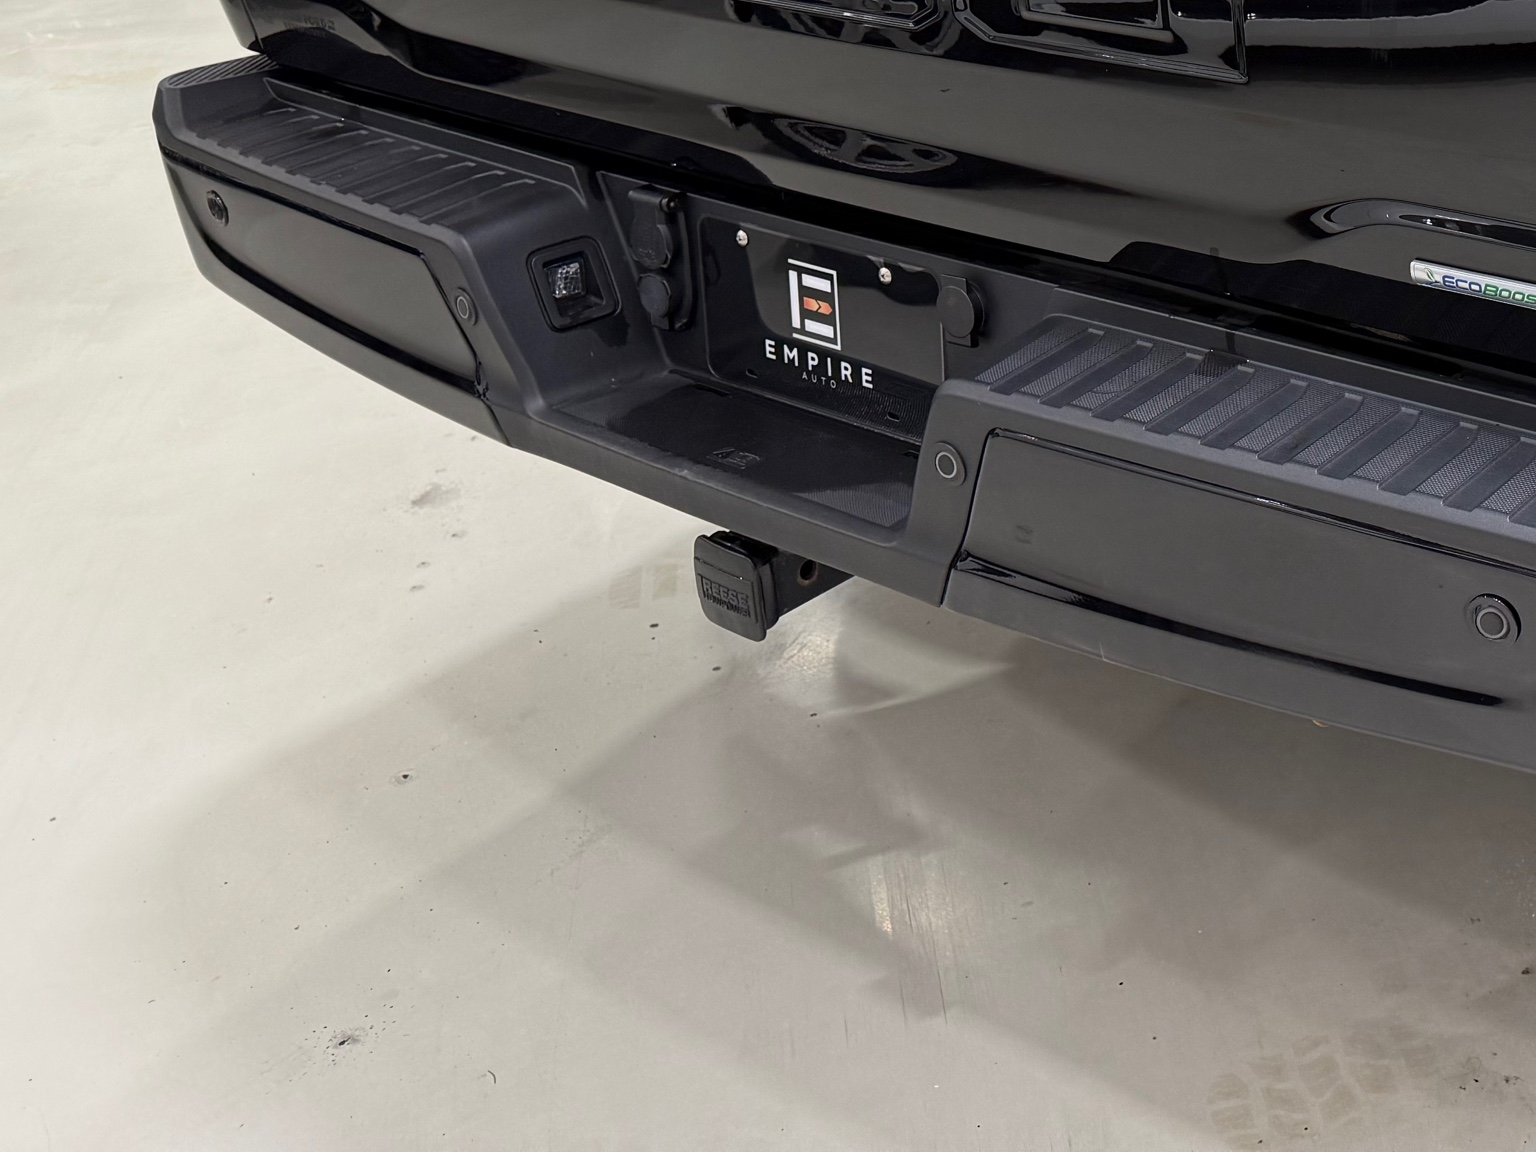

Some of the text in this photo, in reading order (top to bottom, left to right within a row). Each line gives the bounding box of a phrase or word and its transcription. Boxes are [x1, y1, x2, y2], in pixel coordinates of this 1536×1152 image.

[765, 339, 873, 389] EMPIRE
[802, 371, 837, 389] AUTO
[702, 578, 749, 608] REESE
